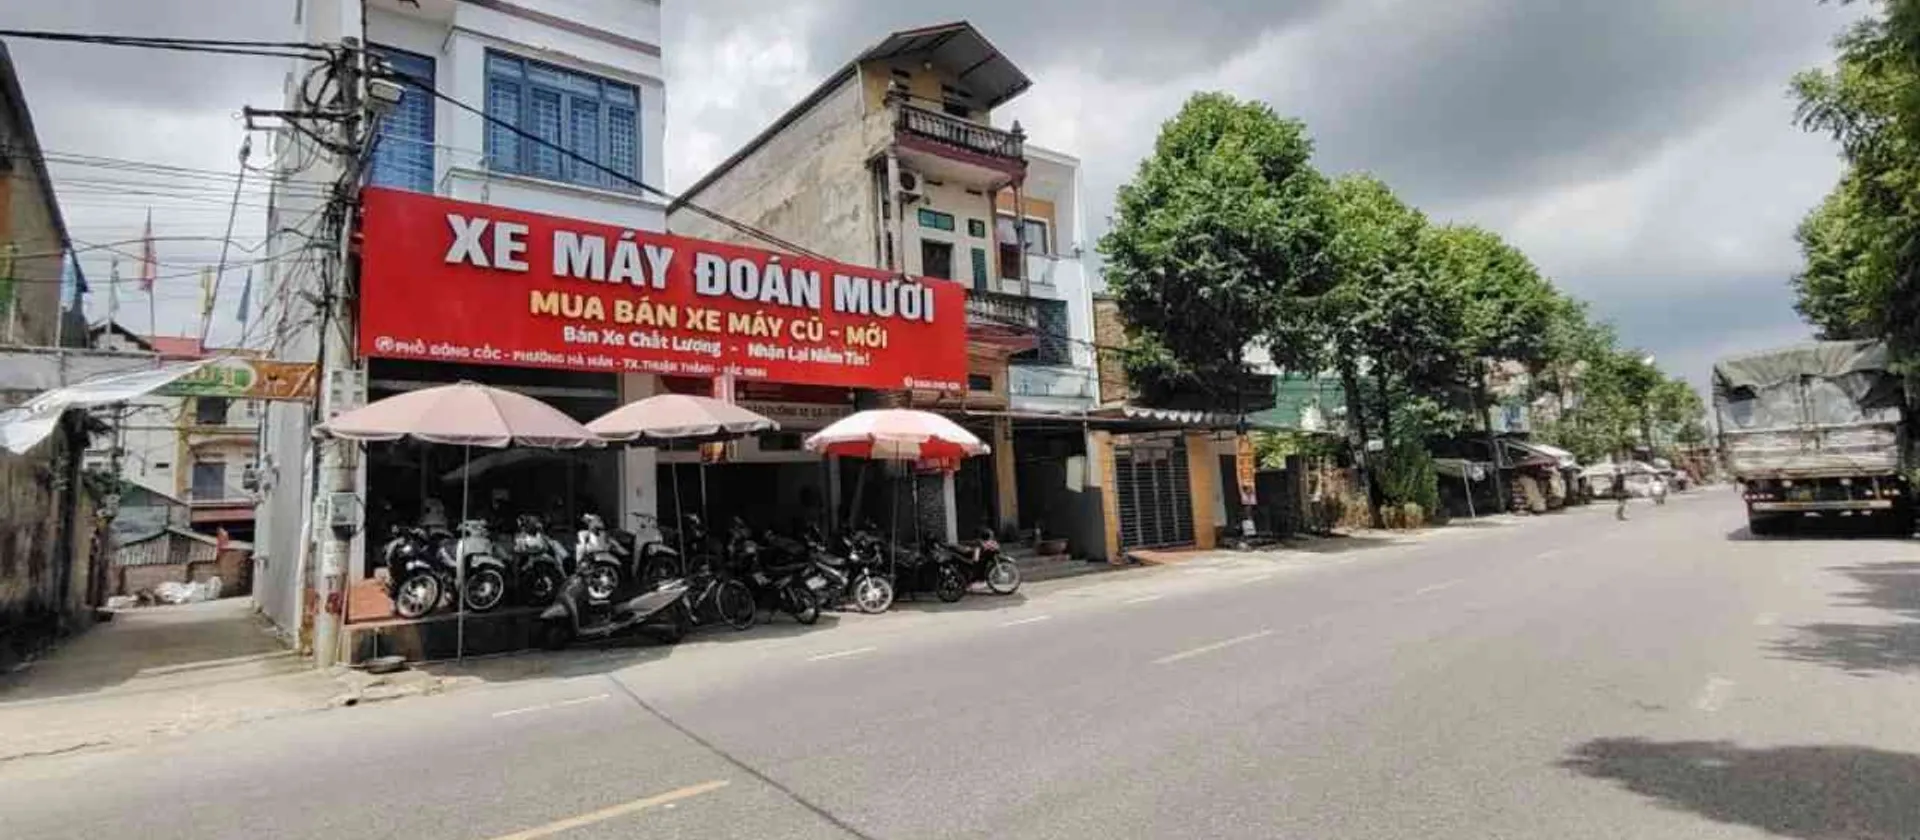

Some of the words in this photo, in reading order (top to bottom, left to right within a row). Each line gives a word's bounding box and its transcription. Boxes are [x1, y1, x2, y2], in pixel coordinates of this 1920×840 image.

[445, 214, 529, 271] XE
[553, 231, 674, 289] MÁY
[694, 252, 821, 309] ĐOÁN
[833, 274, 935, 323] MƯỜI
[530, 290, 605, 322] MUA
[614, 296, 677, 328] BÁN
[686, 307, 722, 333] XE
[728, 310, 783, 338] MÁY
[790, 316, 824, 342] CŨ
[846, 321, 888, 349] MỚI
[563, 325, 599, 344] Bán
[602, 328, 625, 346] Xe
[628, 330, 669, 350] Chất
[672, 335, 721, 357] Lượng
[748, 342, 786, 361] Nhận
[788, 346, 809, 363] Lại
